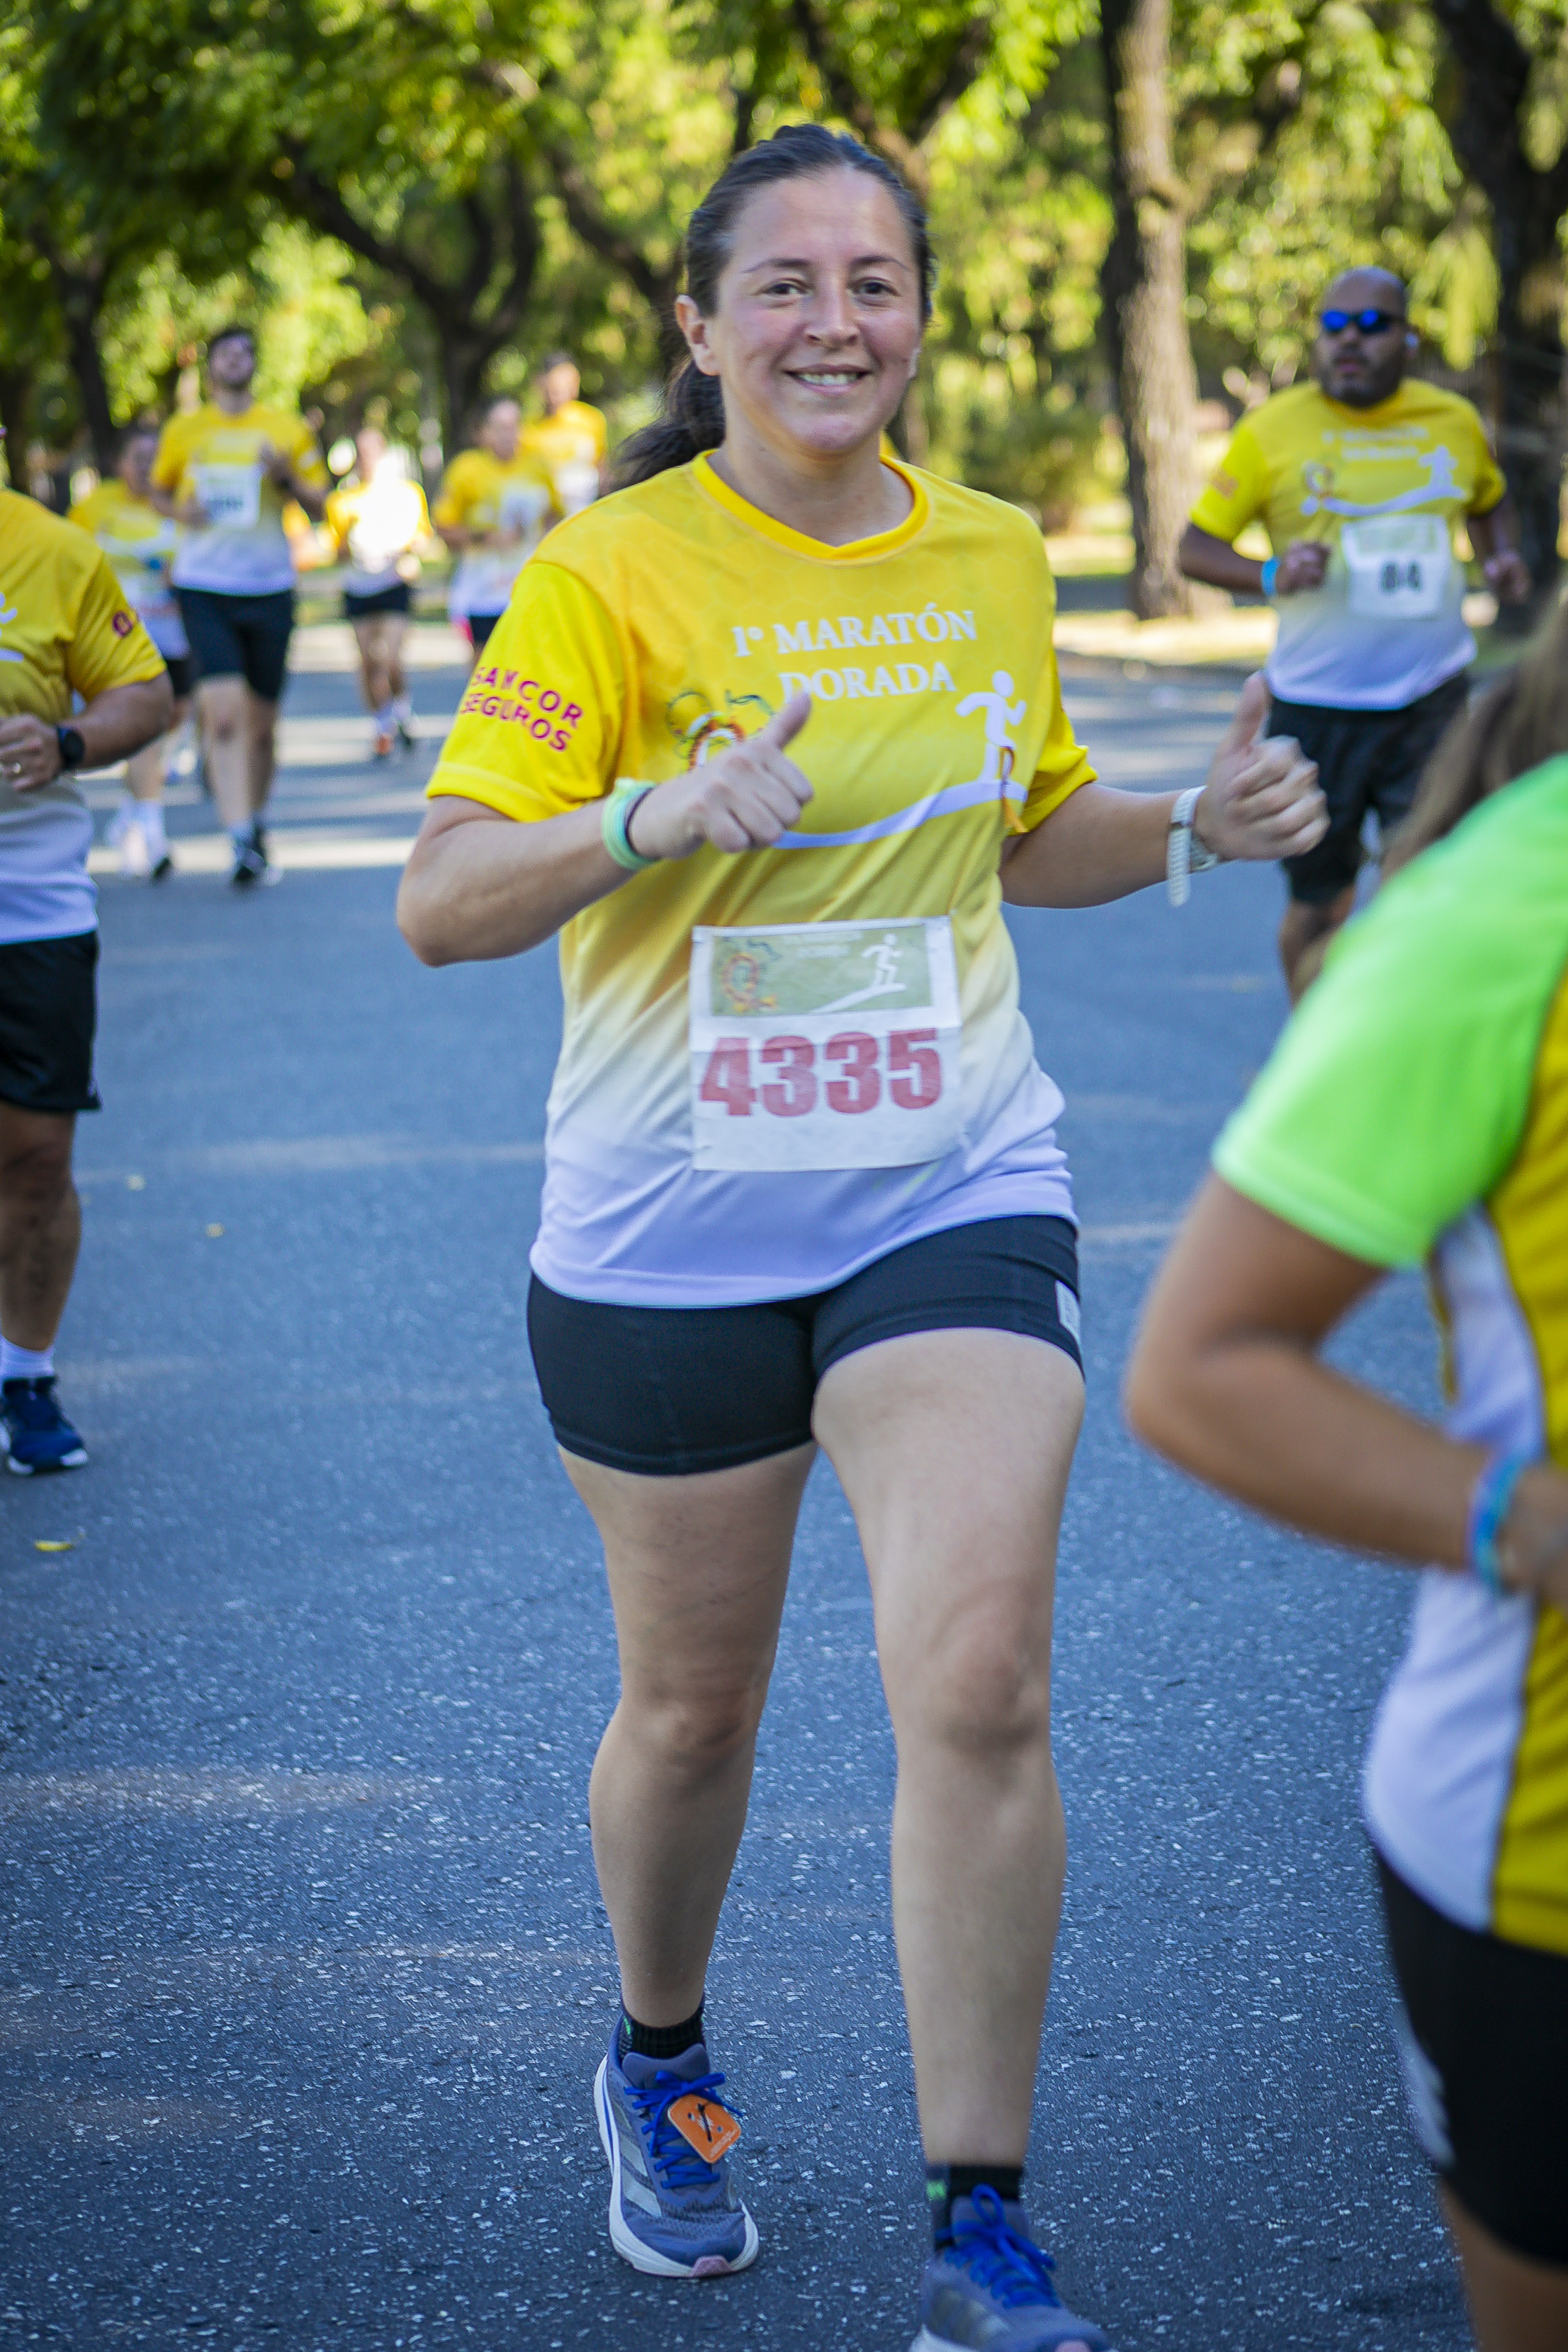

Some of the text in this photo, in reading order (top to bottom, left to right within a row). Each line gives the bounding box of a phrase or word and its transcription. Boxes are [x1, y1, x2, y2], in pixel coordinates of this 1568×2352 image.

[772, 602, 978, 655] MARATÓN
[777, 661, 957, 702] DORADA
[460, 692, 573, 753] SEGUROS
[699, 1028, 944, 1118] 4335
